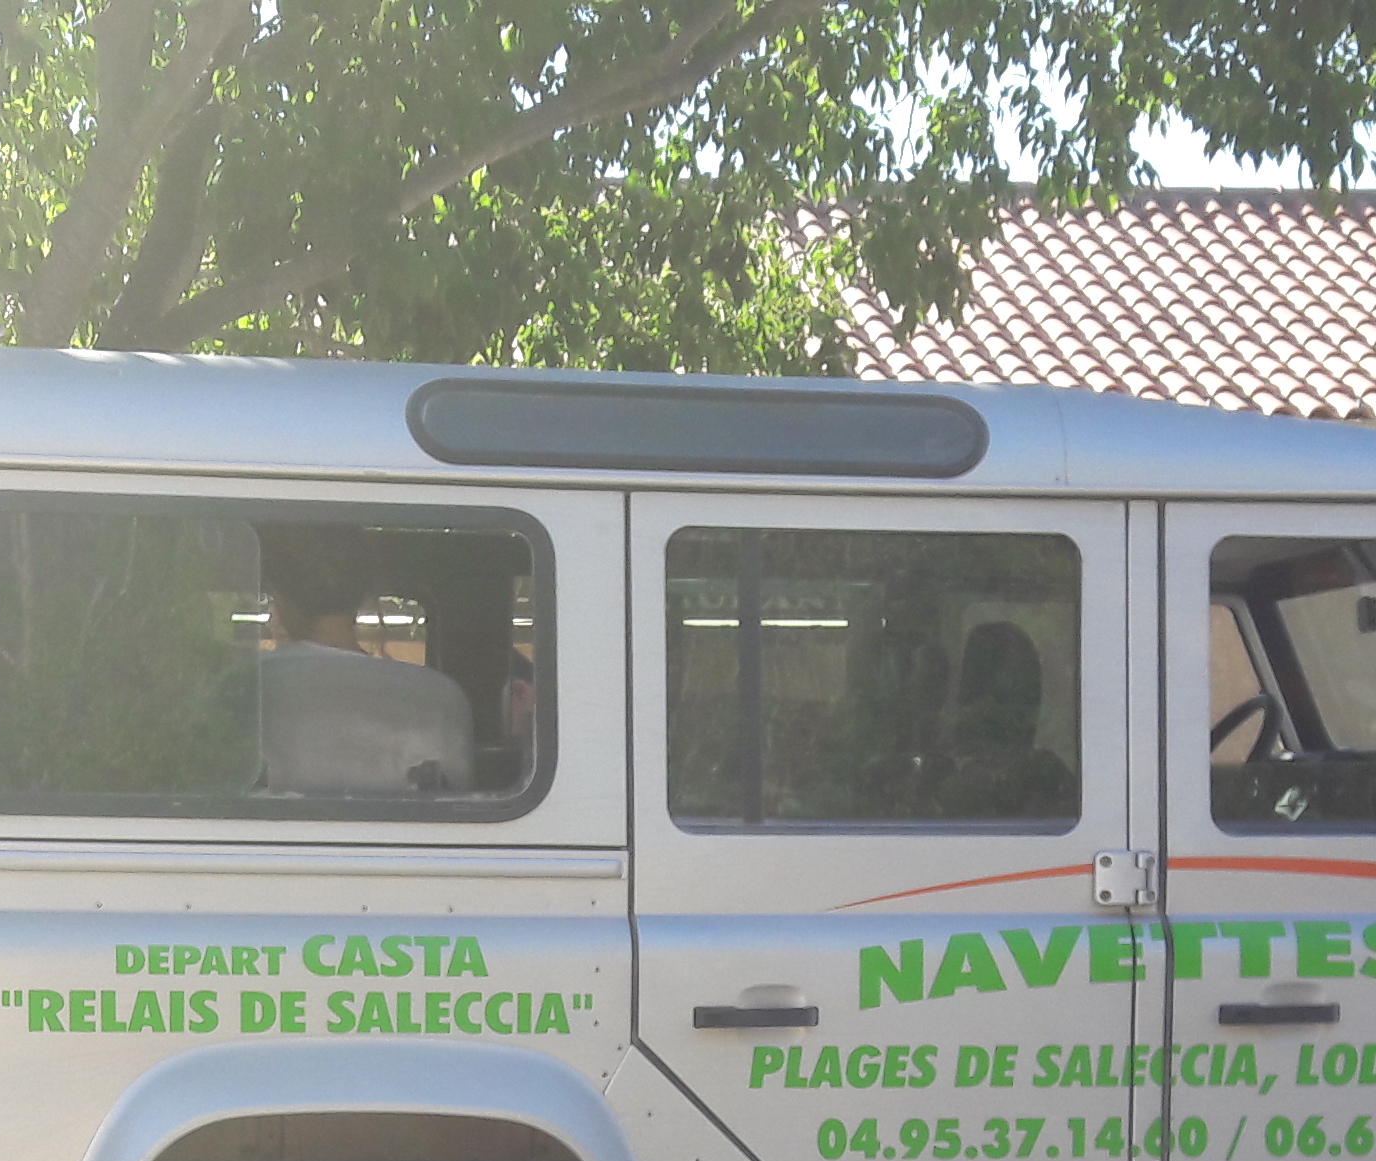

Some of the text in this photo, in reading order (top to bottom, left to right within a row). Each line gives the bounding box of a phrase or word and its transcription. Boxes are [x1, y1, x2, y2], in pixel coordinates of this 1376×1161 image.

[115, 935, 488, 978] DEPART CASTA
[2, 989, 593, 1035] "RELAIS DE SALECCIA"
[749, 1044, 938, 1089] PLAGES
[955, 1045, 1019, 1087] DE
[1032, 1043, 1278, 1095] SALECCIA,
[817, 1115, 1209, 1160] 04.95.37.14.60
[1226, 1116, 1248, 1161] /
